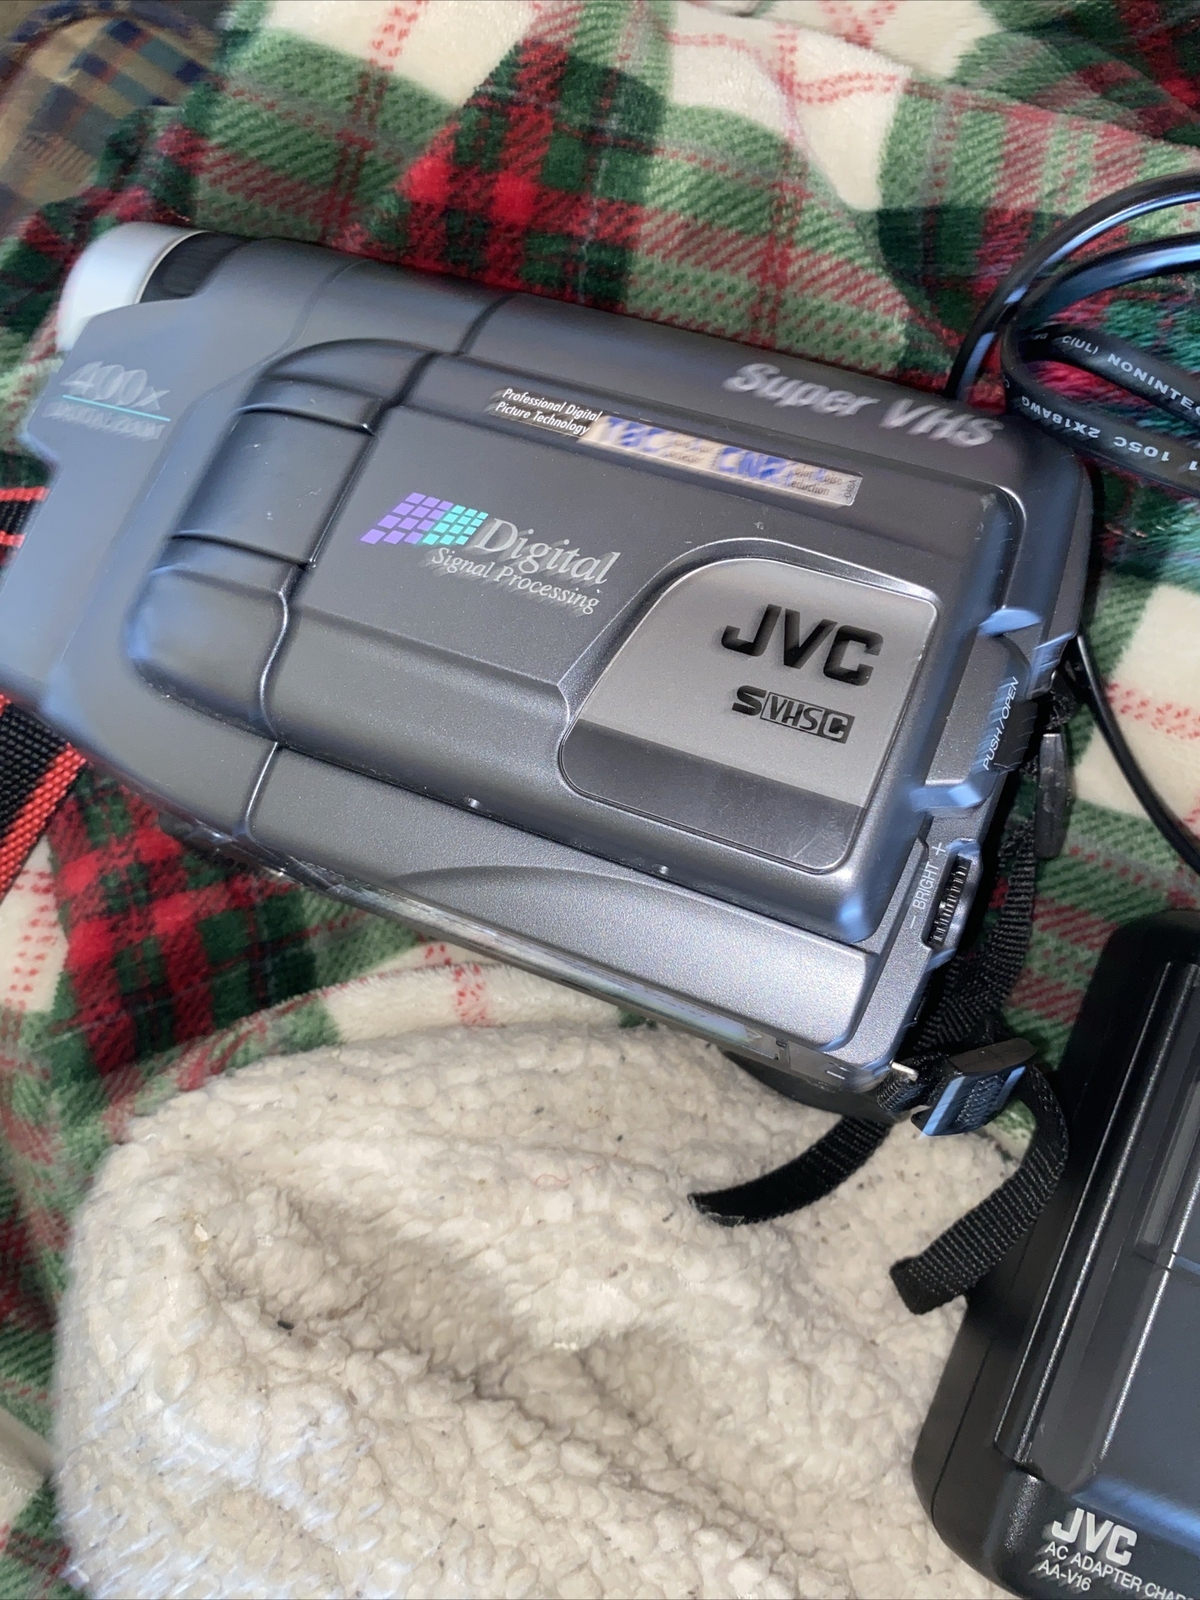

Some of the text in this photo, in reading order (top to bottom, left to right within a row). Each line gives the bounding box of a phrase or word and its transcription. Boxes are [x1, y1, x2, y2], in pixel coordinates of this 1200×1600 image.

[495, 401, 591, 436] Picture Technology
[501, 387, 604, 422] Professional Digital
[723, 363, 1004, 447] Super VHS
[1021, 395, 1101, 439] 2X18AWG
[1113, 436, 1170, 462] 105C
[474, 517, 621, 585] Digital
[431, 547, 600, 615] Signal Processing
[721, 603, 884, 687] JVC
[911, 860, 940, 911] BRIGHT
[1051, 1507, 1138, 1567] JVC
[1038, 1559, 1092, 1592] AA-V16
[1044, 1541, 1195, 1600] AC ADAPTER CHA
